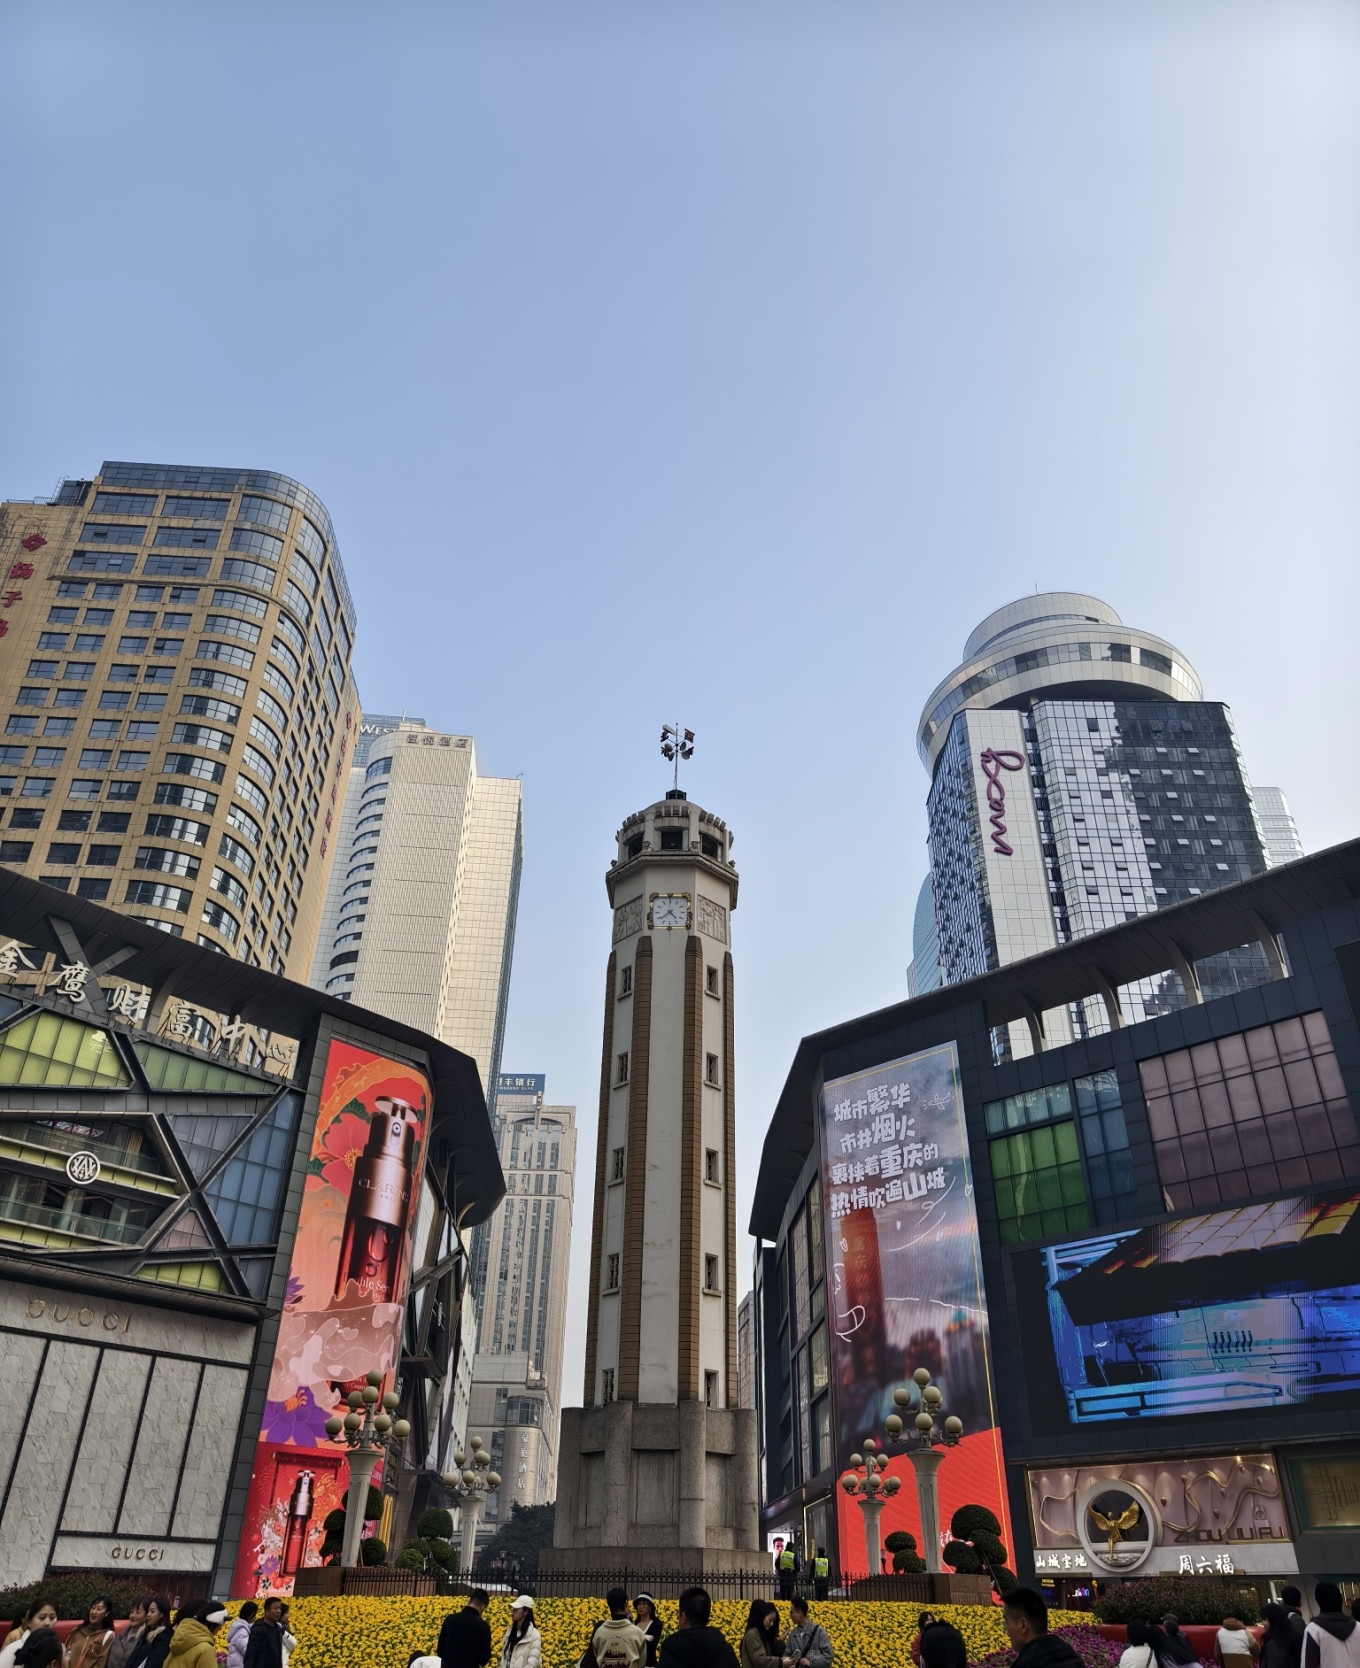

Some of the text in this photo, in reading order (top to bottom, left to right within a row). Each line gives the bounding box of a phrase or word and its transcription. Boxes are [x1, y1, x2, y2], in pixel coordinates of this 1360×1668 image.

[0, 939, 297, 1064] 金鹰财富中心
[833, 1082, 911, 1122] 城市繁华
[840, 1112, 916, 1154] 市井烟火
[832, 1143, 939, 1185] 裹挟着重庆的
[830, 1167, 946, 1219] 热情吹遍山城
[26, 1299, 131, 1335] GUCCI
[111, 1546, 164, 1562] GUCCI
[1036, 1553, 1087, 1569] 山城宝地
[1179, 1553, 1234, 1575] 周六福
